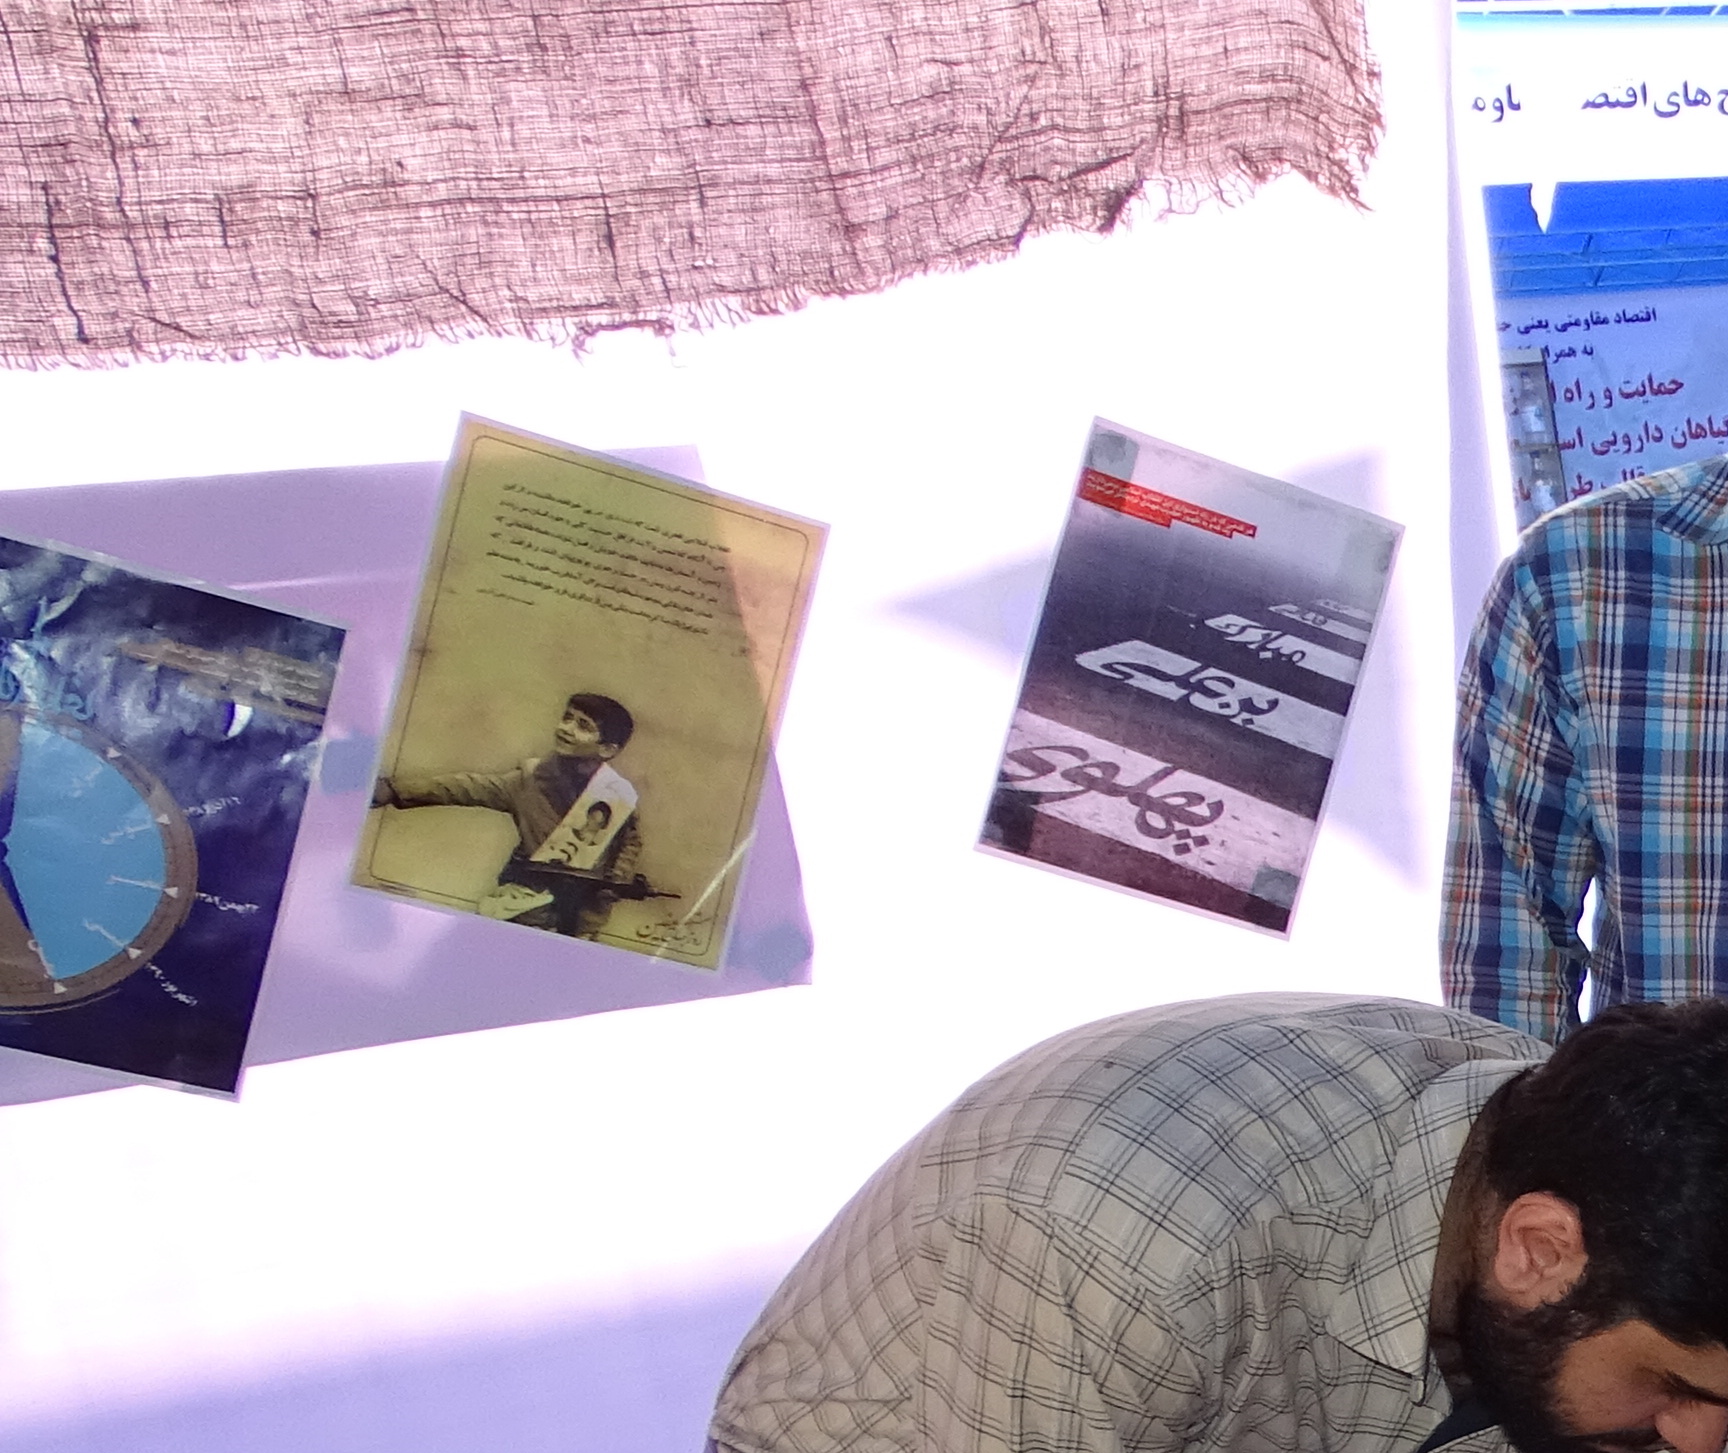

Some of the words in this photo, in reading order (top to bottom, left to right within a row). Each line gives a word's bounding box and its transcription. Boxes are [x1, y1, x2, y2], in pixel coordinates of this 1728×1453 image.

[1653, 80, 1712, 118] های
[1516, 317, 1550, 335] یعنی
[1554, 310, 1610, 333] مقاومتی
[1613, 306, 1658, 324] اقتصاد
[1543, 344, 1578, 364] همرا
[1581, 344, 1595, 360] به
[1563, 377, 1597, 410] راه
[1603, 386, 1614, 409] و
[1618, 371, 1686, 404] حمایت
[1591, 420, 1665, 456] دارویی
[997, 744, 1225, 856] پهلوی
